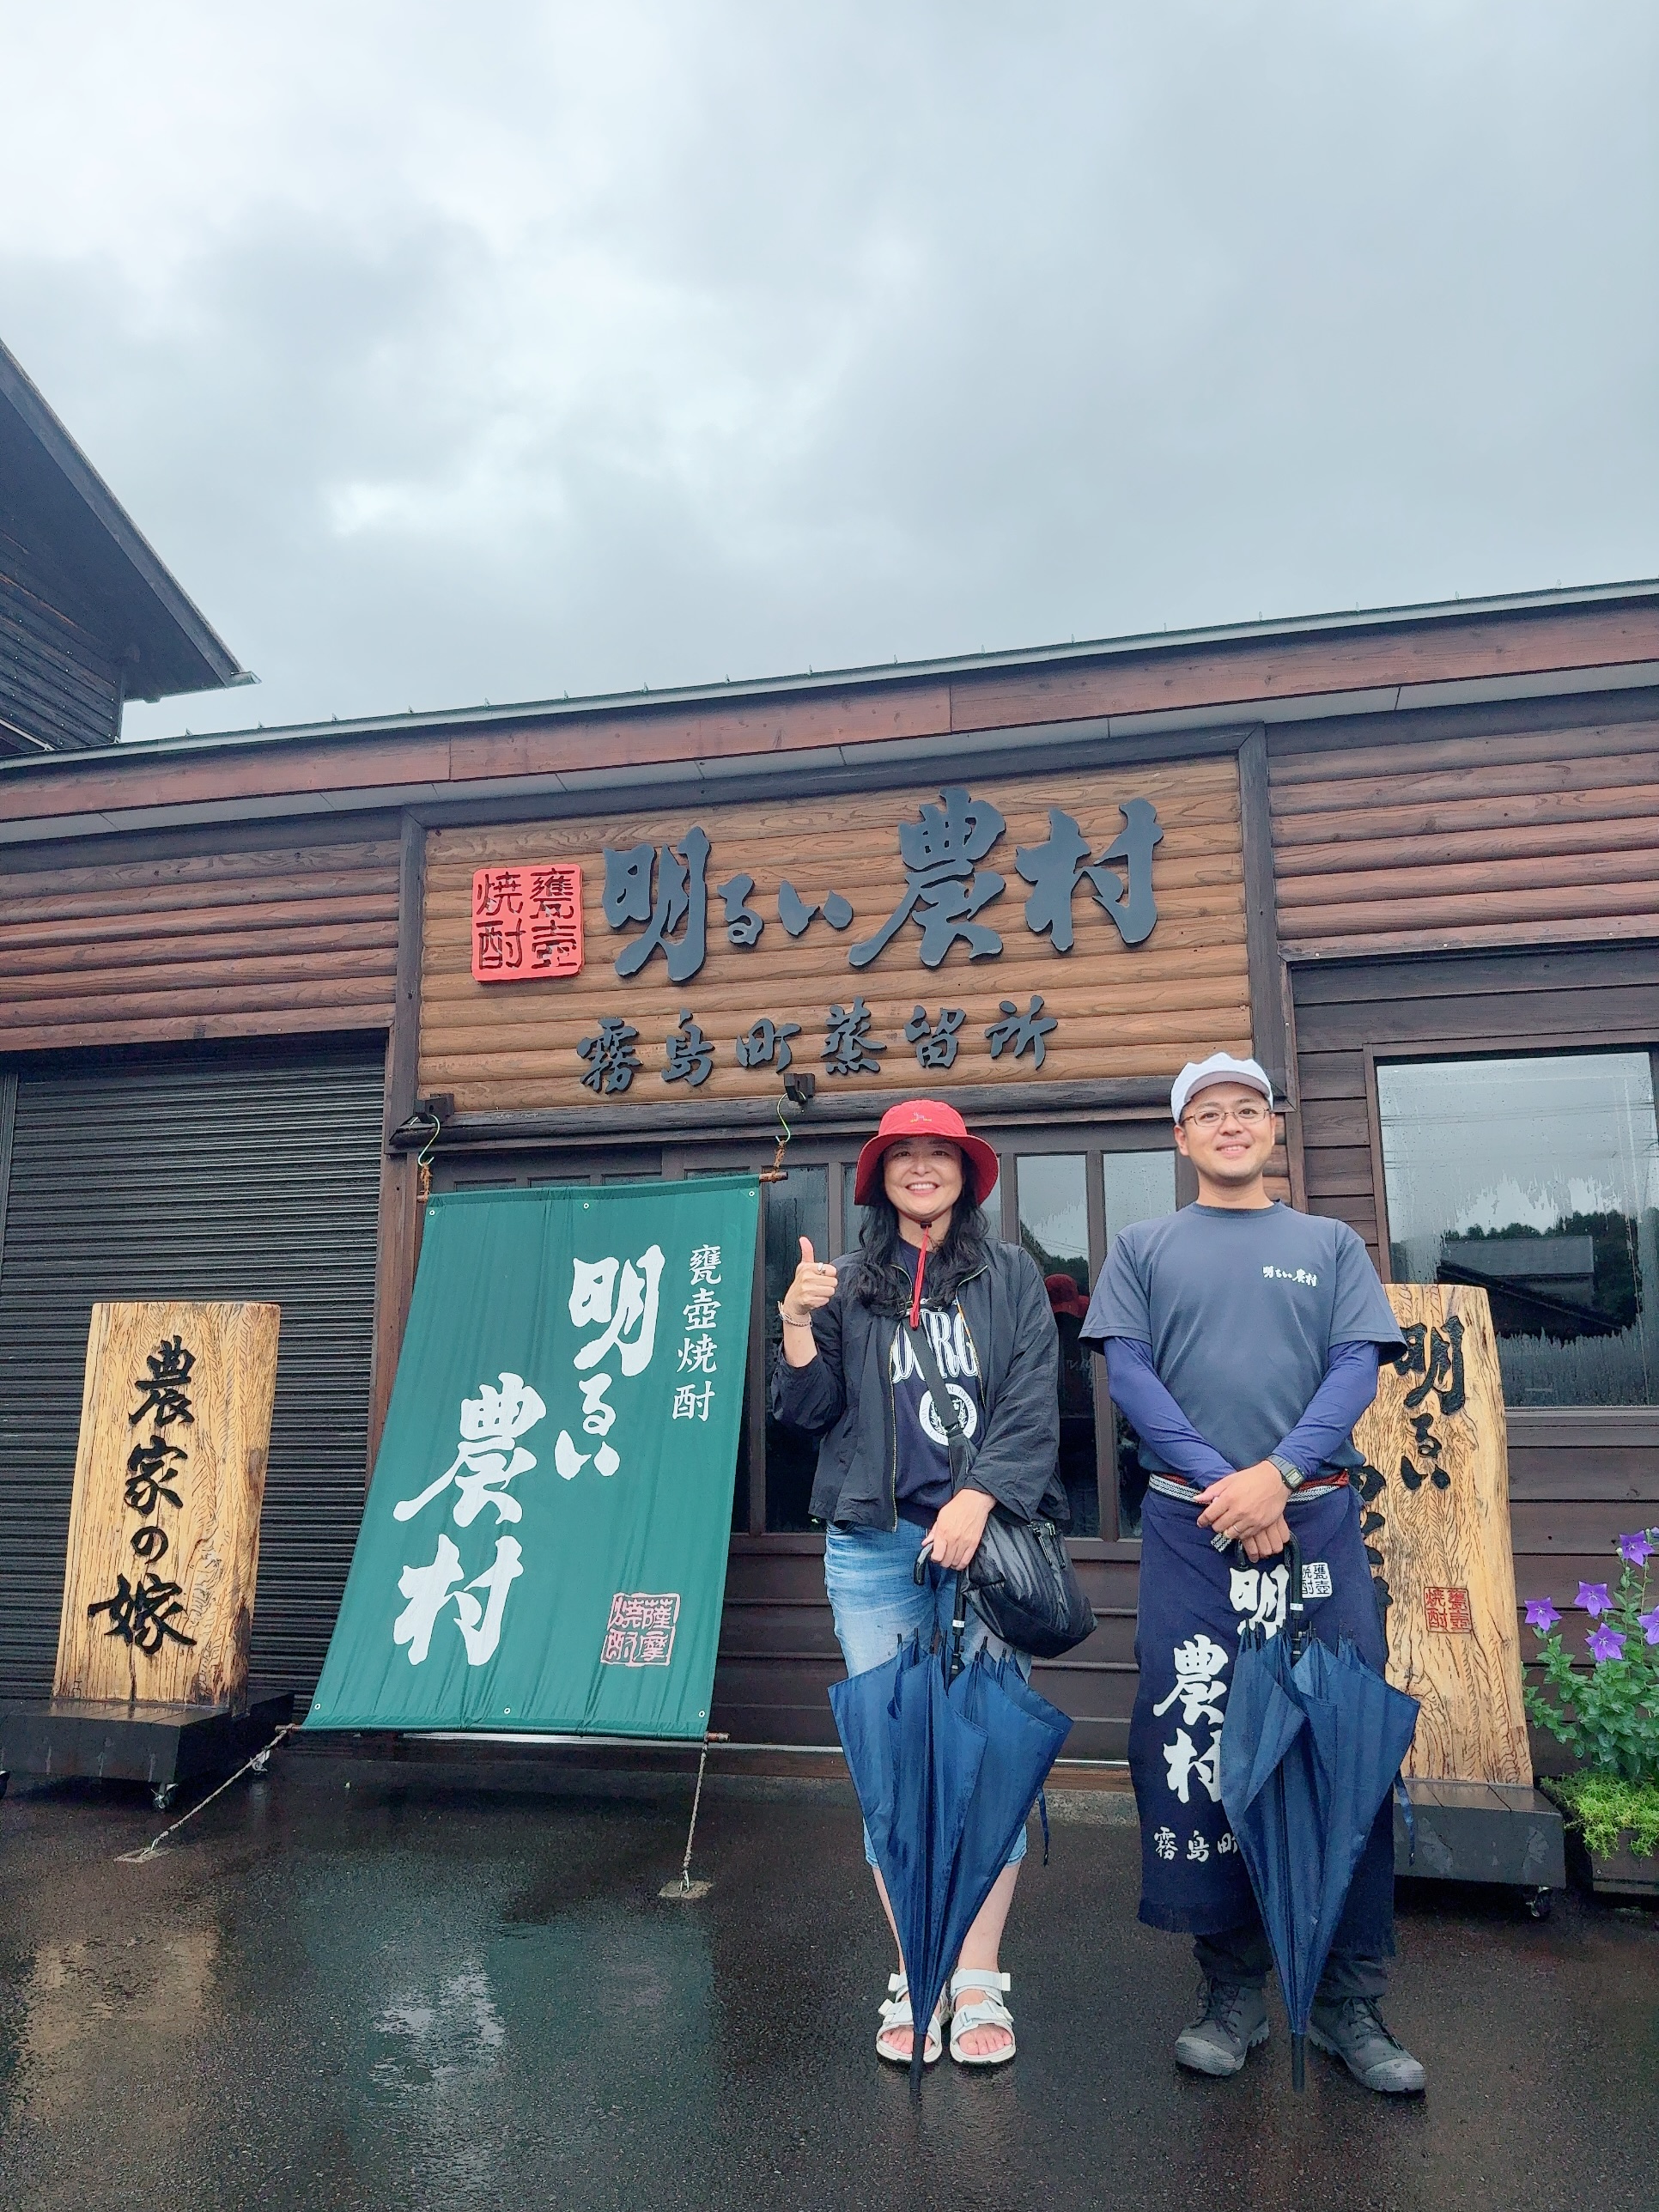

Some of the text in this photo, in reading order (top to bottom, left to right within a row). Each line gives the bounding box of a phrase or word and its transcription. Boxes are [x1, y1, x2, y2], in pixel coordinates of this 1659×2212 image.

[476, 871, 527, 970] 焼酎
[601, 787, 1164, 982] 明るい農村
[576, 994, 1059, 1095] 霧島町蒸留所
[555, 1243, 666, 1481] 明るい
[1261, 1265, 1318, 1287] 明るい農村
[87, 1334, 198, 1656] 農家の嫁
[1393, 1315, 1466, 1492] 明るい
[392, 1371, 547, 1666] 農村
